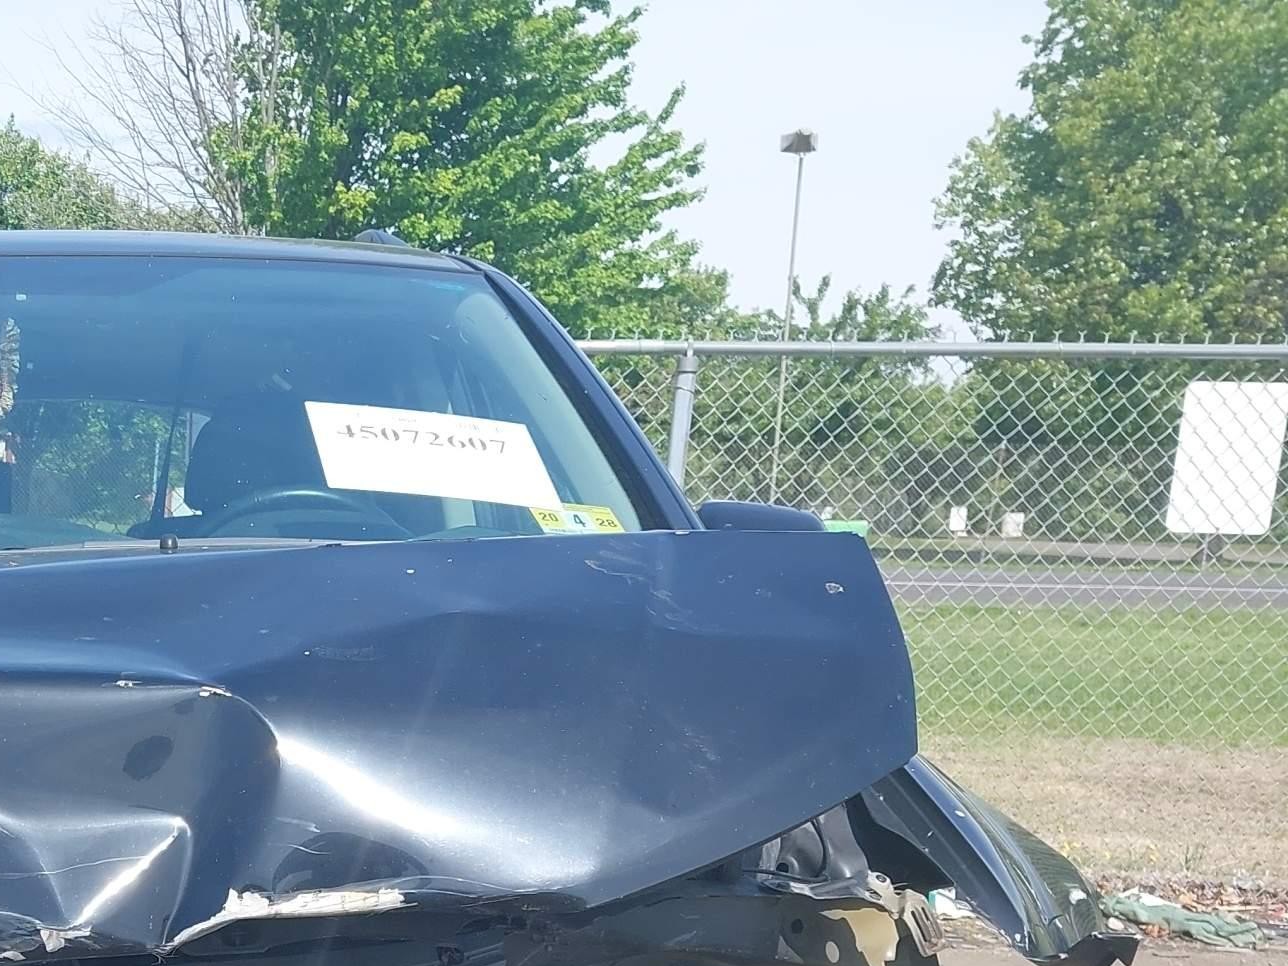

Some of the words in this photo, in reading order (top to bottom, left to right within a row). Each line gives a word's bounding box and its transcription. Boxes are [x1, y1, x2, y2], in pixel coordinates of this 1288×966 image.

[337, 425, 506, 453] 45072607
[538, 511, 560, 522] 20
[572, 513, 587, 528] 4
[595, 517, 618, 528] 28
